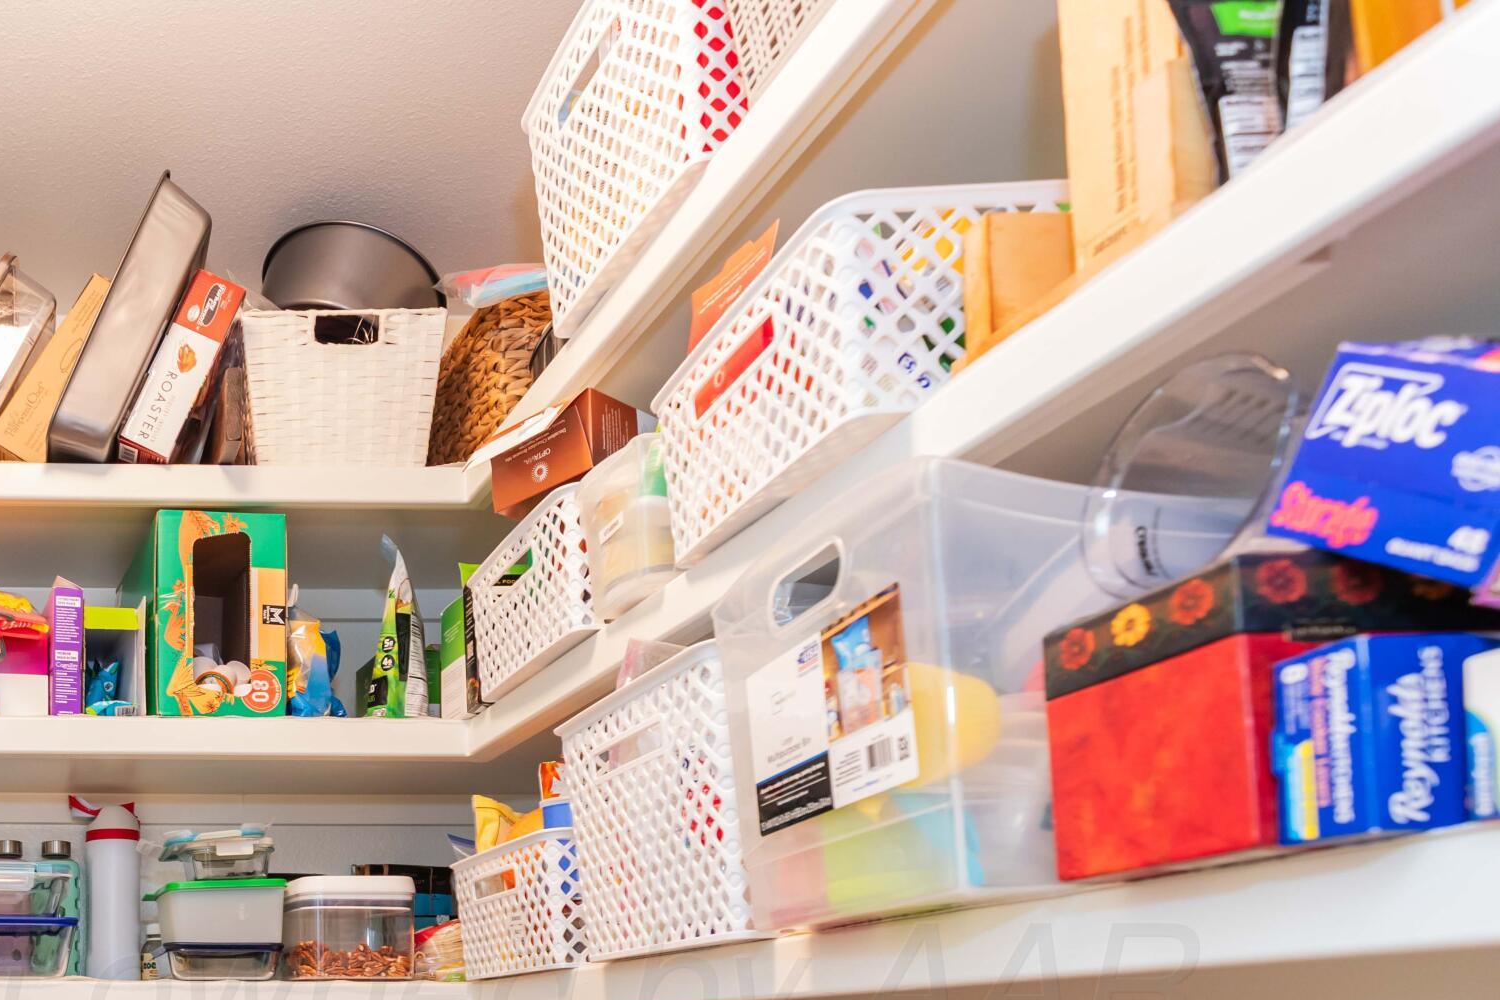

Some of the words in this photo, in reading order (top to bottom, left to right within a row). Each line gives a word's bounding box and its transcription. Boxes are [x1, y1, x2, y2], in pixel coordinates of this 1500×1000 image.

[138, 371, 179, 440] ROASTER
[1323, 375, 1469, 448] Ziploc
[251, 678, 270, 704] 80
[1386, 673, 1438, 824] Reynolds
